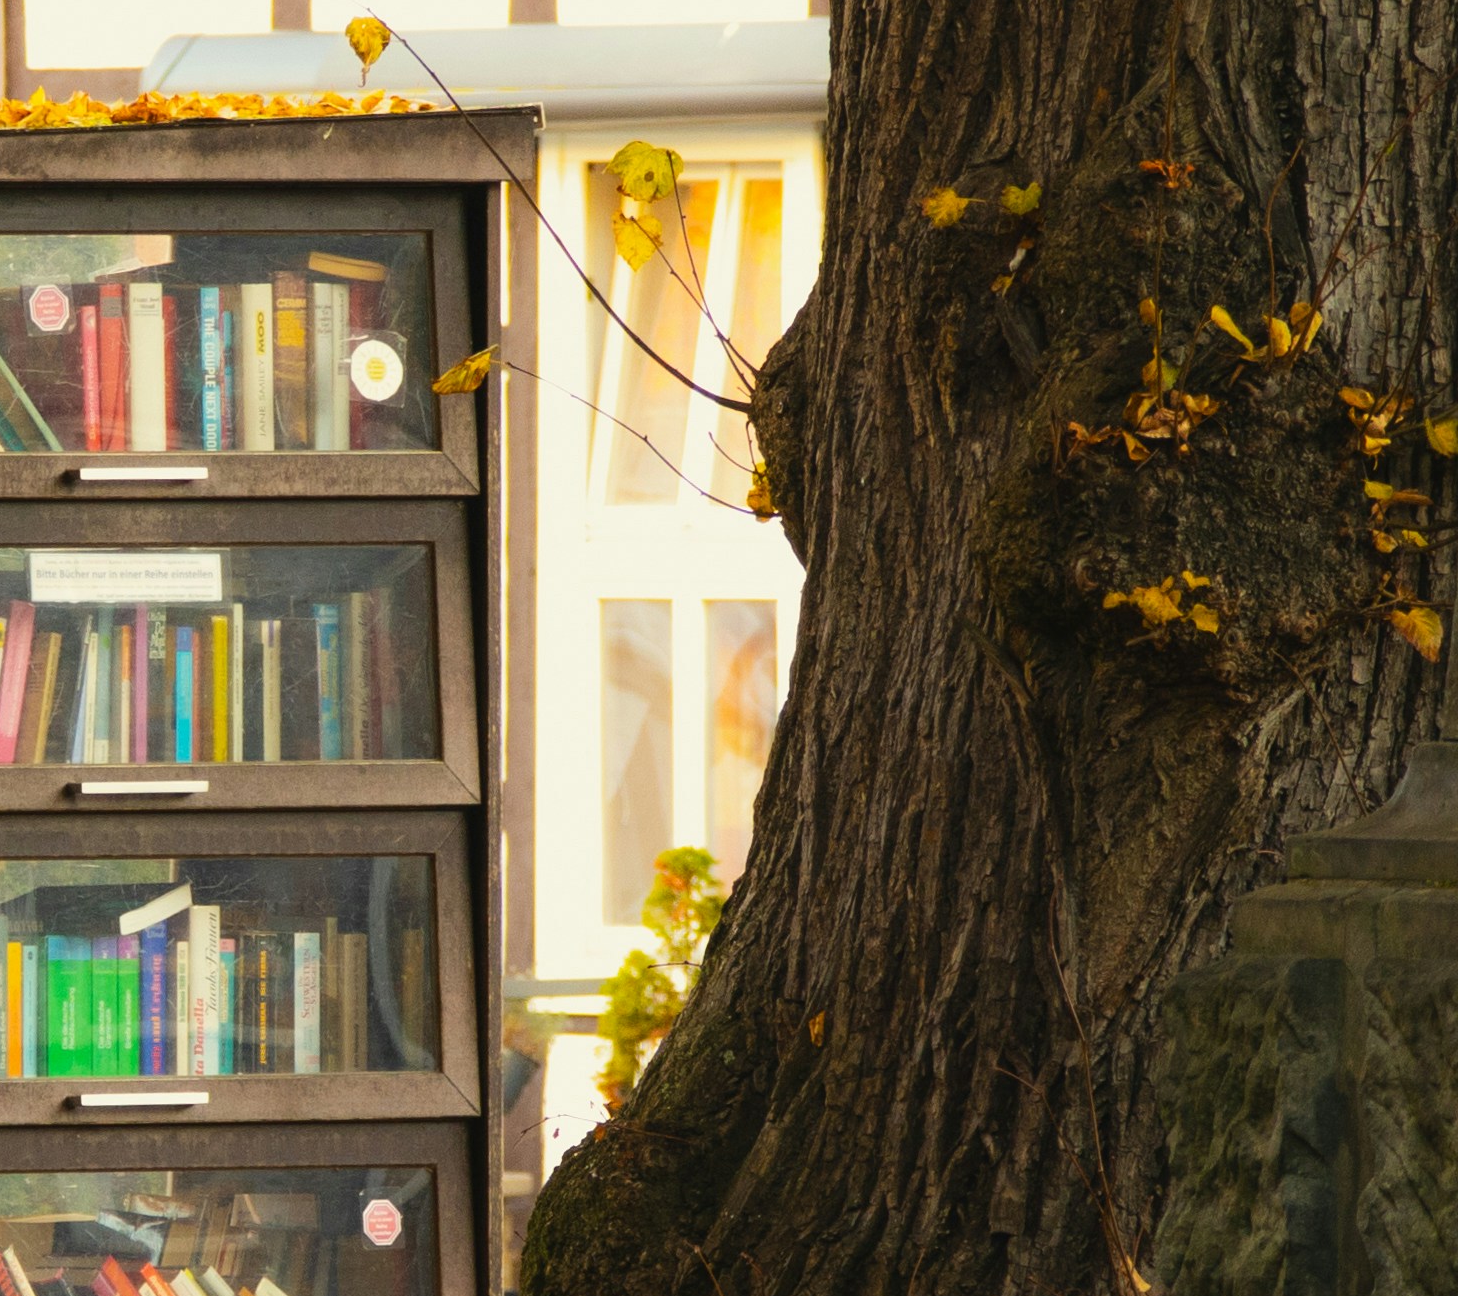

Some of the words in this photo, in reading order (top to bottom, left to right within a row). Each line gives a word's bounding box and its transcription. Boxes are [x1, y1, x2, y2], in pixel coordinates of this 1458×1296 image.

[204, 316, 216, 340] THE
[256, 311, 264, 354] MOO
[204, 341, 217, 387] COUPLE
[258, 359, 266, 403] SMILEY
[205, 391, 217, 420] NEXT
[258, 406, 267, 438] JANE
[35, 568, 58, 580] Bitte
[59, 568, 90, 580] Bücher
[92, 570, 107, 580] nur
[108, 569, 118, 580] in
[119, 569, 142, 580] einer
[144, 568, 169, 580] Reihe
[170, 568, 214, 580] einstellen
[205, 911, 218, 965] Frauen
[259, 950, 267, 979] FIRMA
[205, 968, 218, 1016] Jacobs
[301, 947, 311, 1019] SCHWESTERN
[61, 1000, 69, 1035] deutsche
[97, 1000, 105, 1035] deutsche
[193, 998, 205, 1055] Danella
[259, 1001, 267, 1041] GRISHAM
[194, 1060, 205, 1075] ta
[259, 1042, 268, 1065] JOHN
